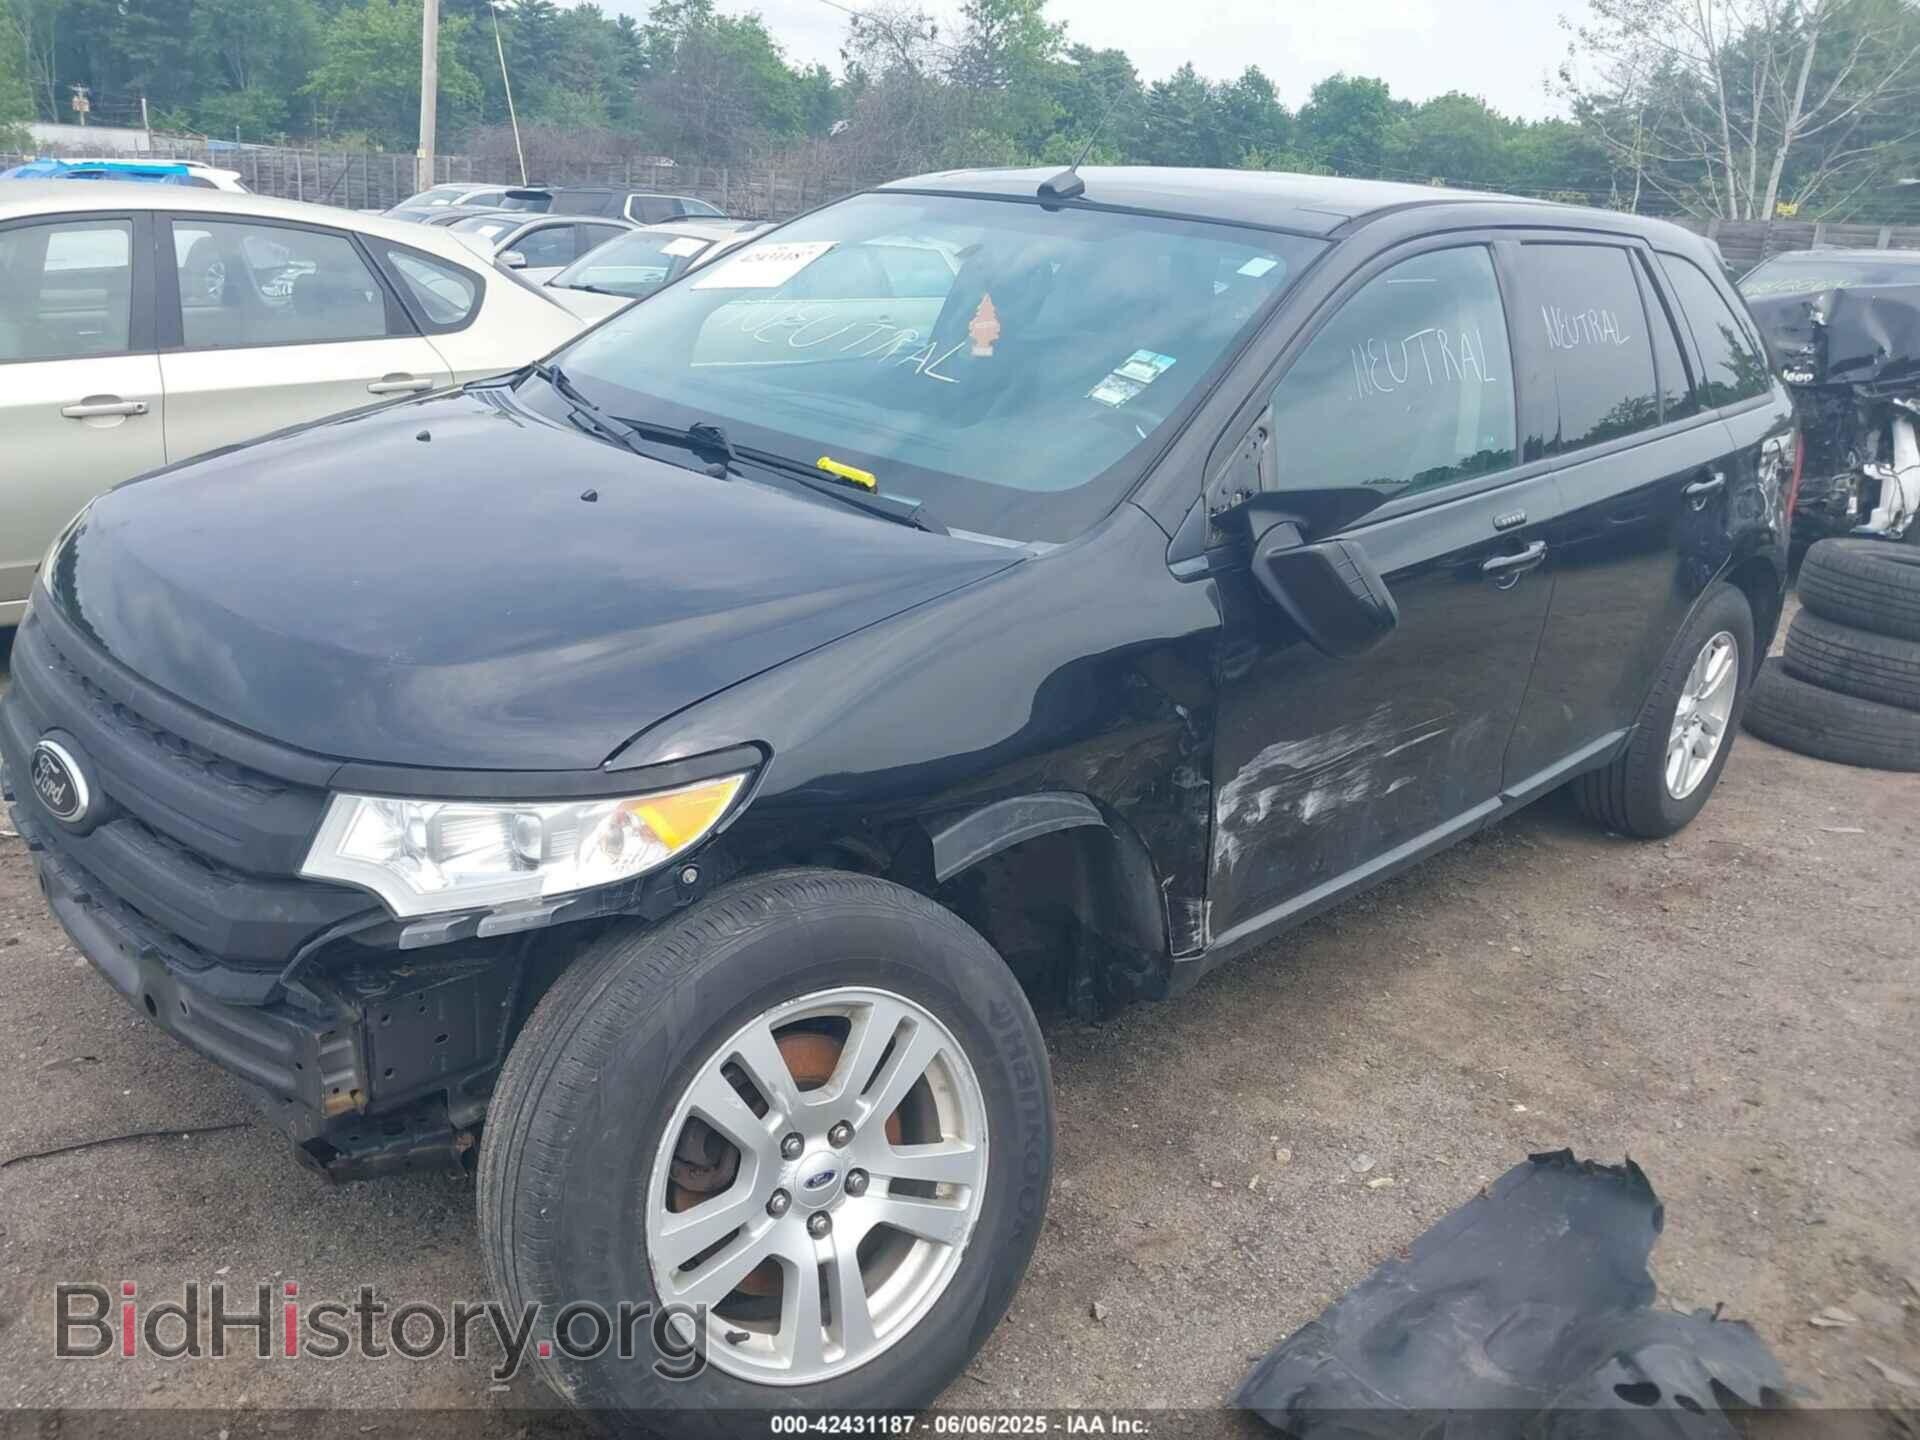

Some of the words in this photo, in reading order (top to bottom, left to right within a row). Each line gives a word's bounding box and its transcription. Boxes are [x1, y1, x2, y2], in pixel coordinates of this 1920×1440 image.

[1541, 303, 1632, 350] NEUTRAL
[1351, 327, 1497, 400] NEUTRAL
[34, 753, 66, 806] Ford
